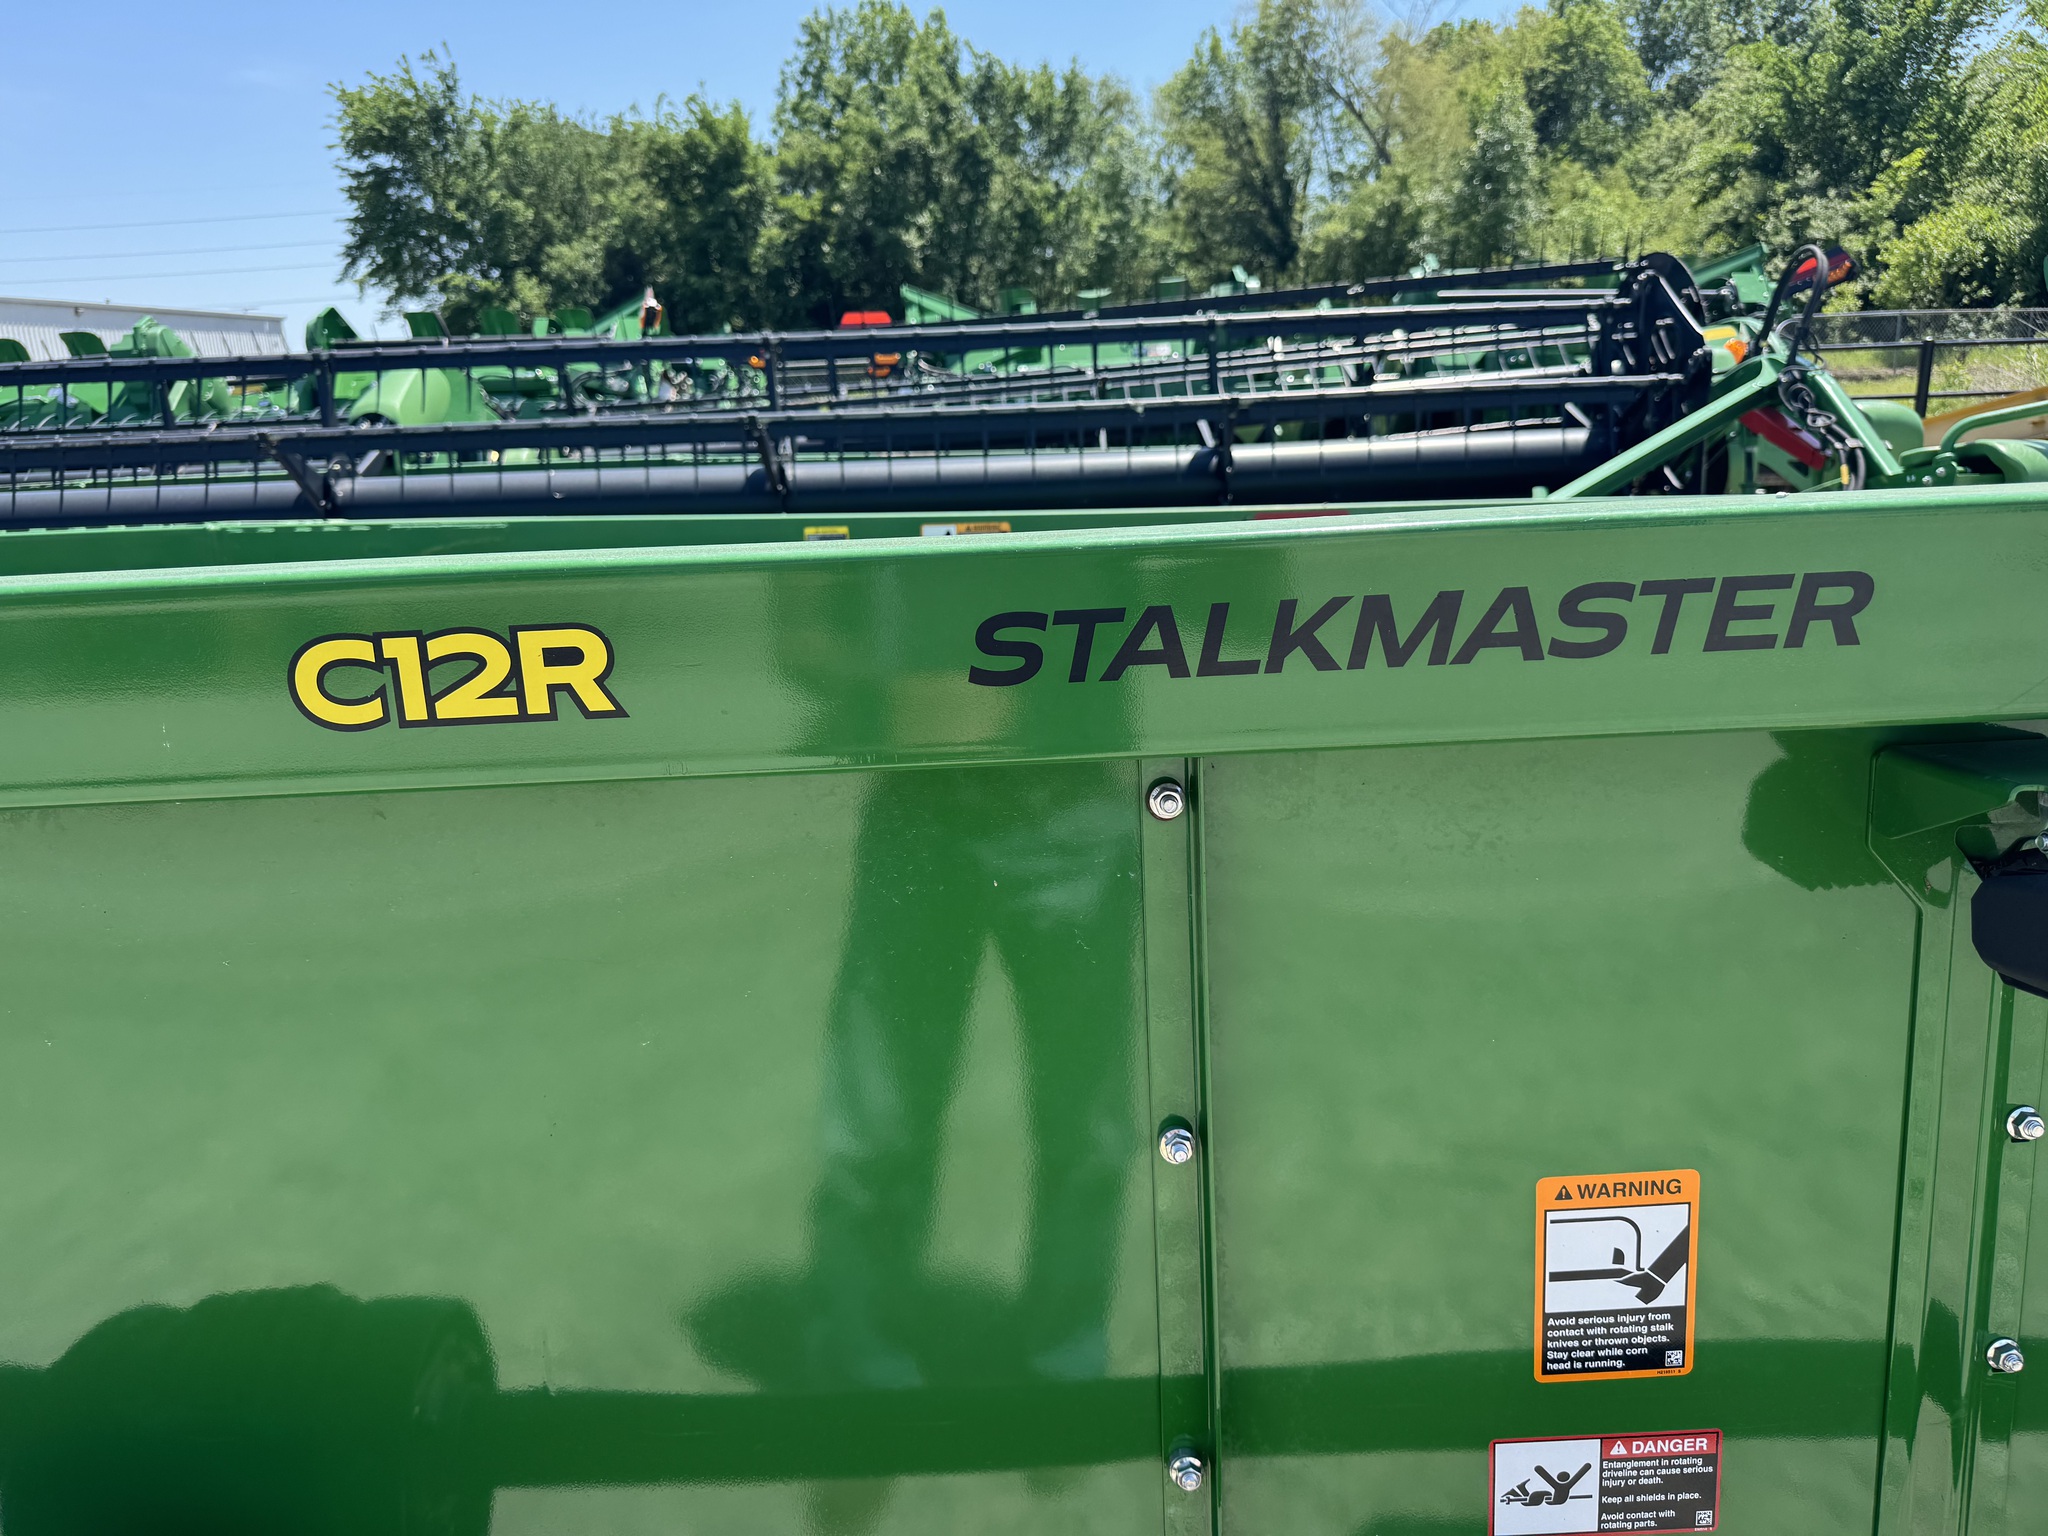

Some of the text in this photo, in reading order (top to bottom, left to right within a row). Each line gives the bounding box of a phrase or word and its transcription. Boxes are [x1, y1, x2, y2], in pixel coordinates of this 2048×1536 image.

[968, 570, 1875, 687] STALKMASTER
[288, 623, 629, 731] C12R
[1577, 1178, 1681, 1199] WARNING
[1548, 1312, 1671, 1326] Avoid serious injury from
[1547, 1323, 1674, 1337] contact with rotating stalk
[1547, 1335, 1670, 1347] knives or thrown objects.
[1547, 1347, 1648, 1360] Stay clear while corn
[1546, 1358, 1625, 1370] head is running.
[1632, 1438, 1707, 1454] DANGER
[1602, 1459, 1659, 1470] Entanglement
[1671, 1457, 1703, 1466] rotating
[1602, 1469, 1638, 1478] driveline
[1683, 1465, 1713, 1473] serious
[1602, 1479, 1626, 1487] injury
[1638, 1476, 1663, 1485] death.
[1601, 1495, 1622, 1505] Keep
[1624, 1494, 1634, 1502] all
[1636, 1493, 1665, 1502] shields
[1677, 1492, 1701, 1501] place.
[1601, 1510, 1675, 1520] Avoid contact with
[1601, 1519, 1657, 1530] rotating parts.
